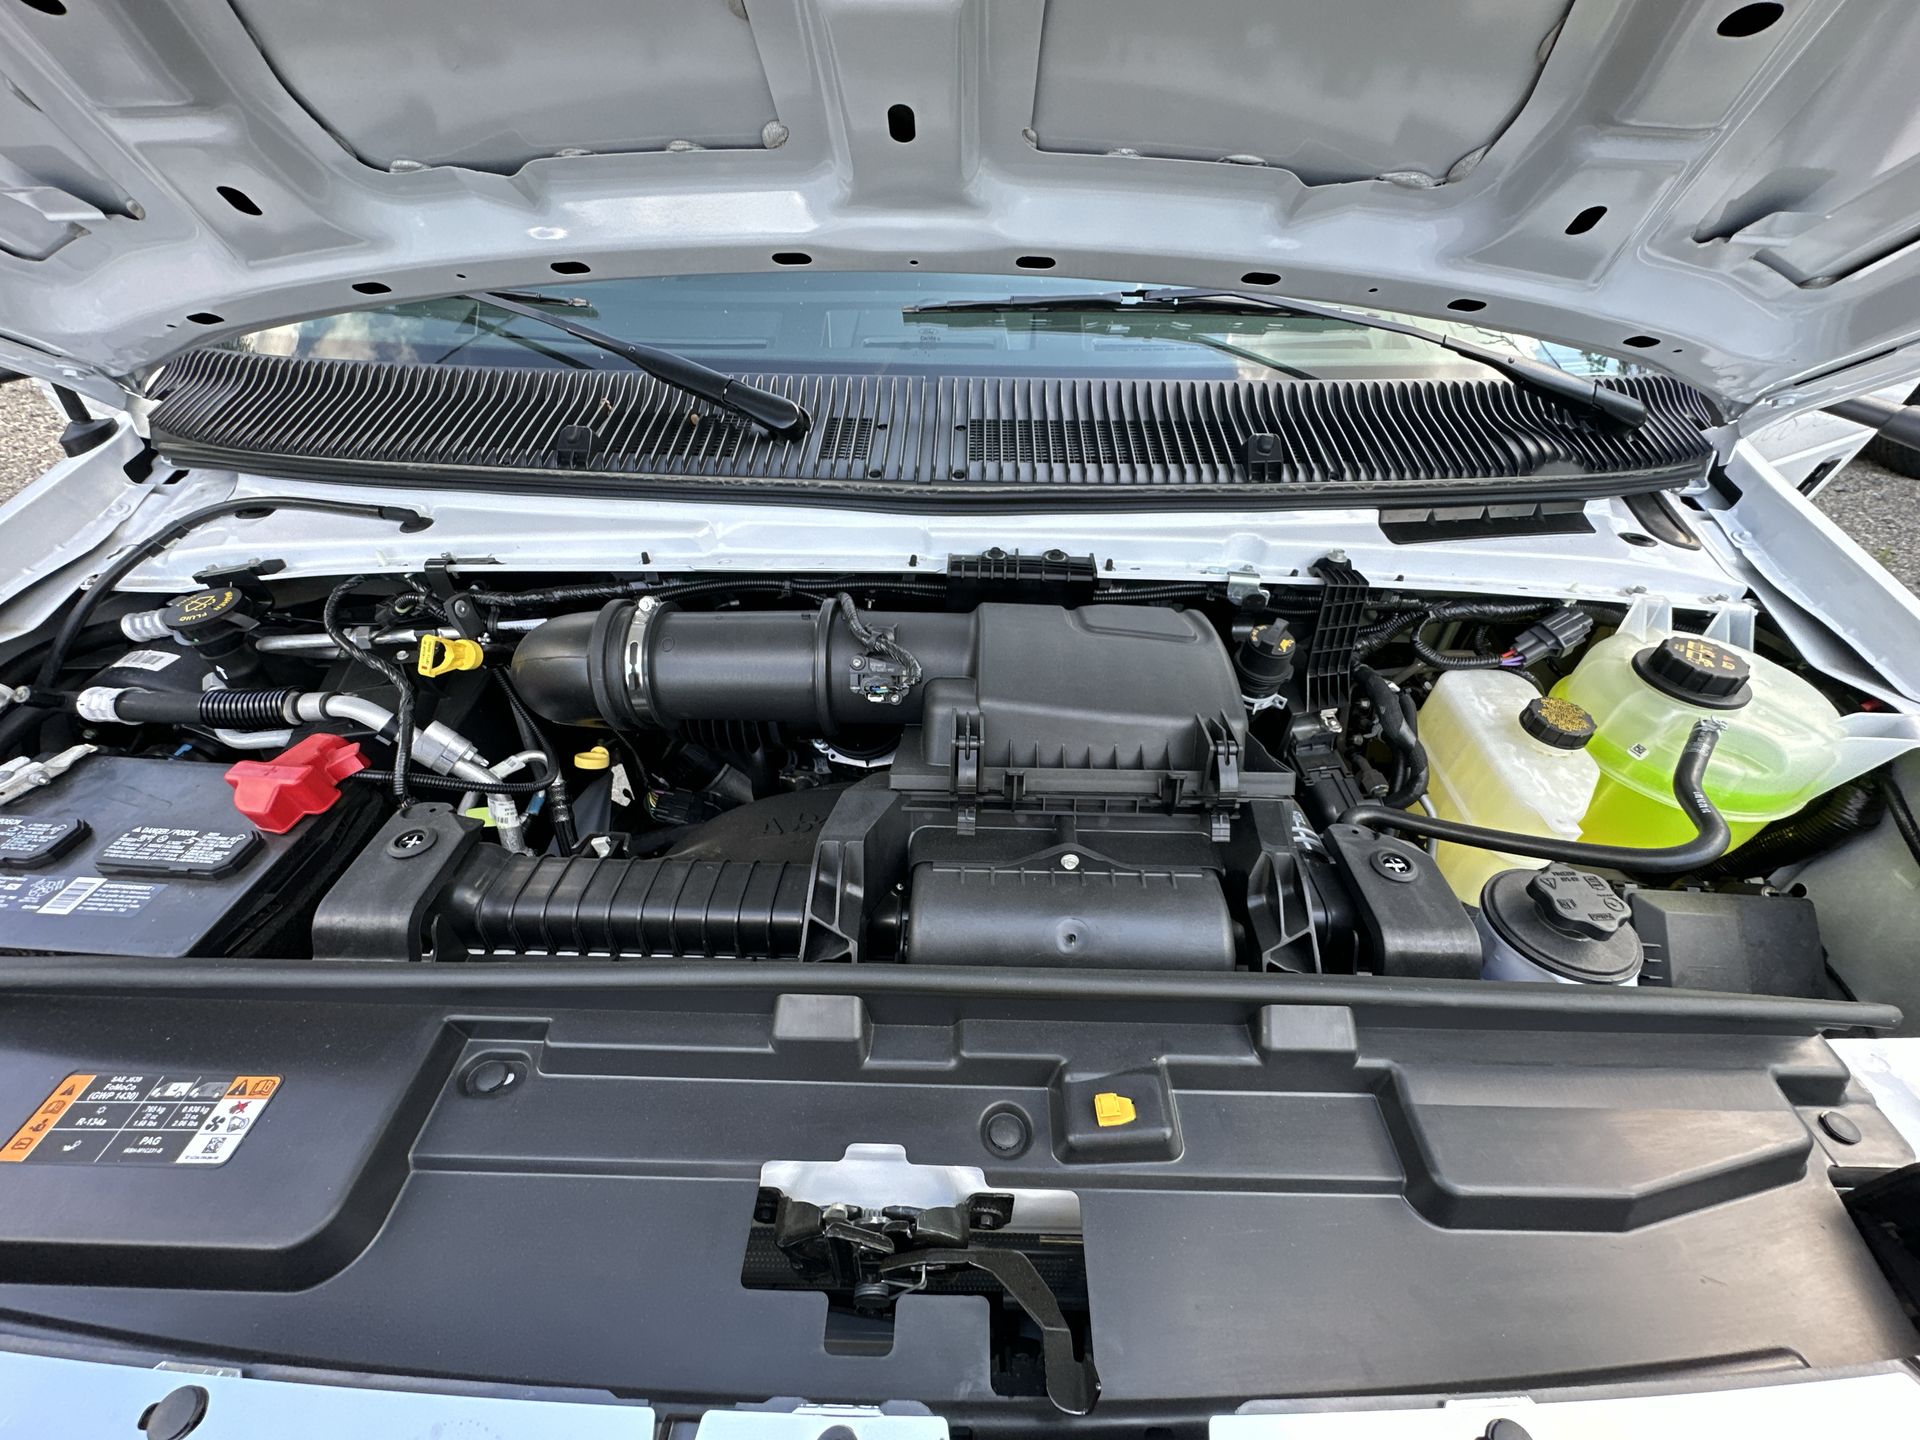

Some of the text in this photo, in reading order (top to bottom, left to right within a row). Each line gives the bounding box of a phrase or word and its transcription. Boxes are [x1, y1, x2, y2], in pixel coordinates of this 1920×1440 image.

[179, 612, 208, 622] FLUID
[87, 1092, 139, 1101] (GWP 1430)
[156, 1105, 166, 1114] kg
[200, 1105, 210, 1114] kg
[75, 1117, 107, 1126] R-134a
[139, 1136, 161, 1145] PAG
